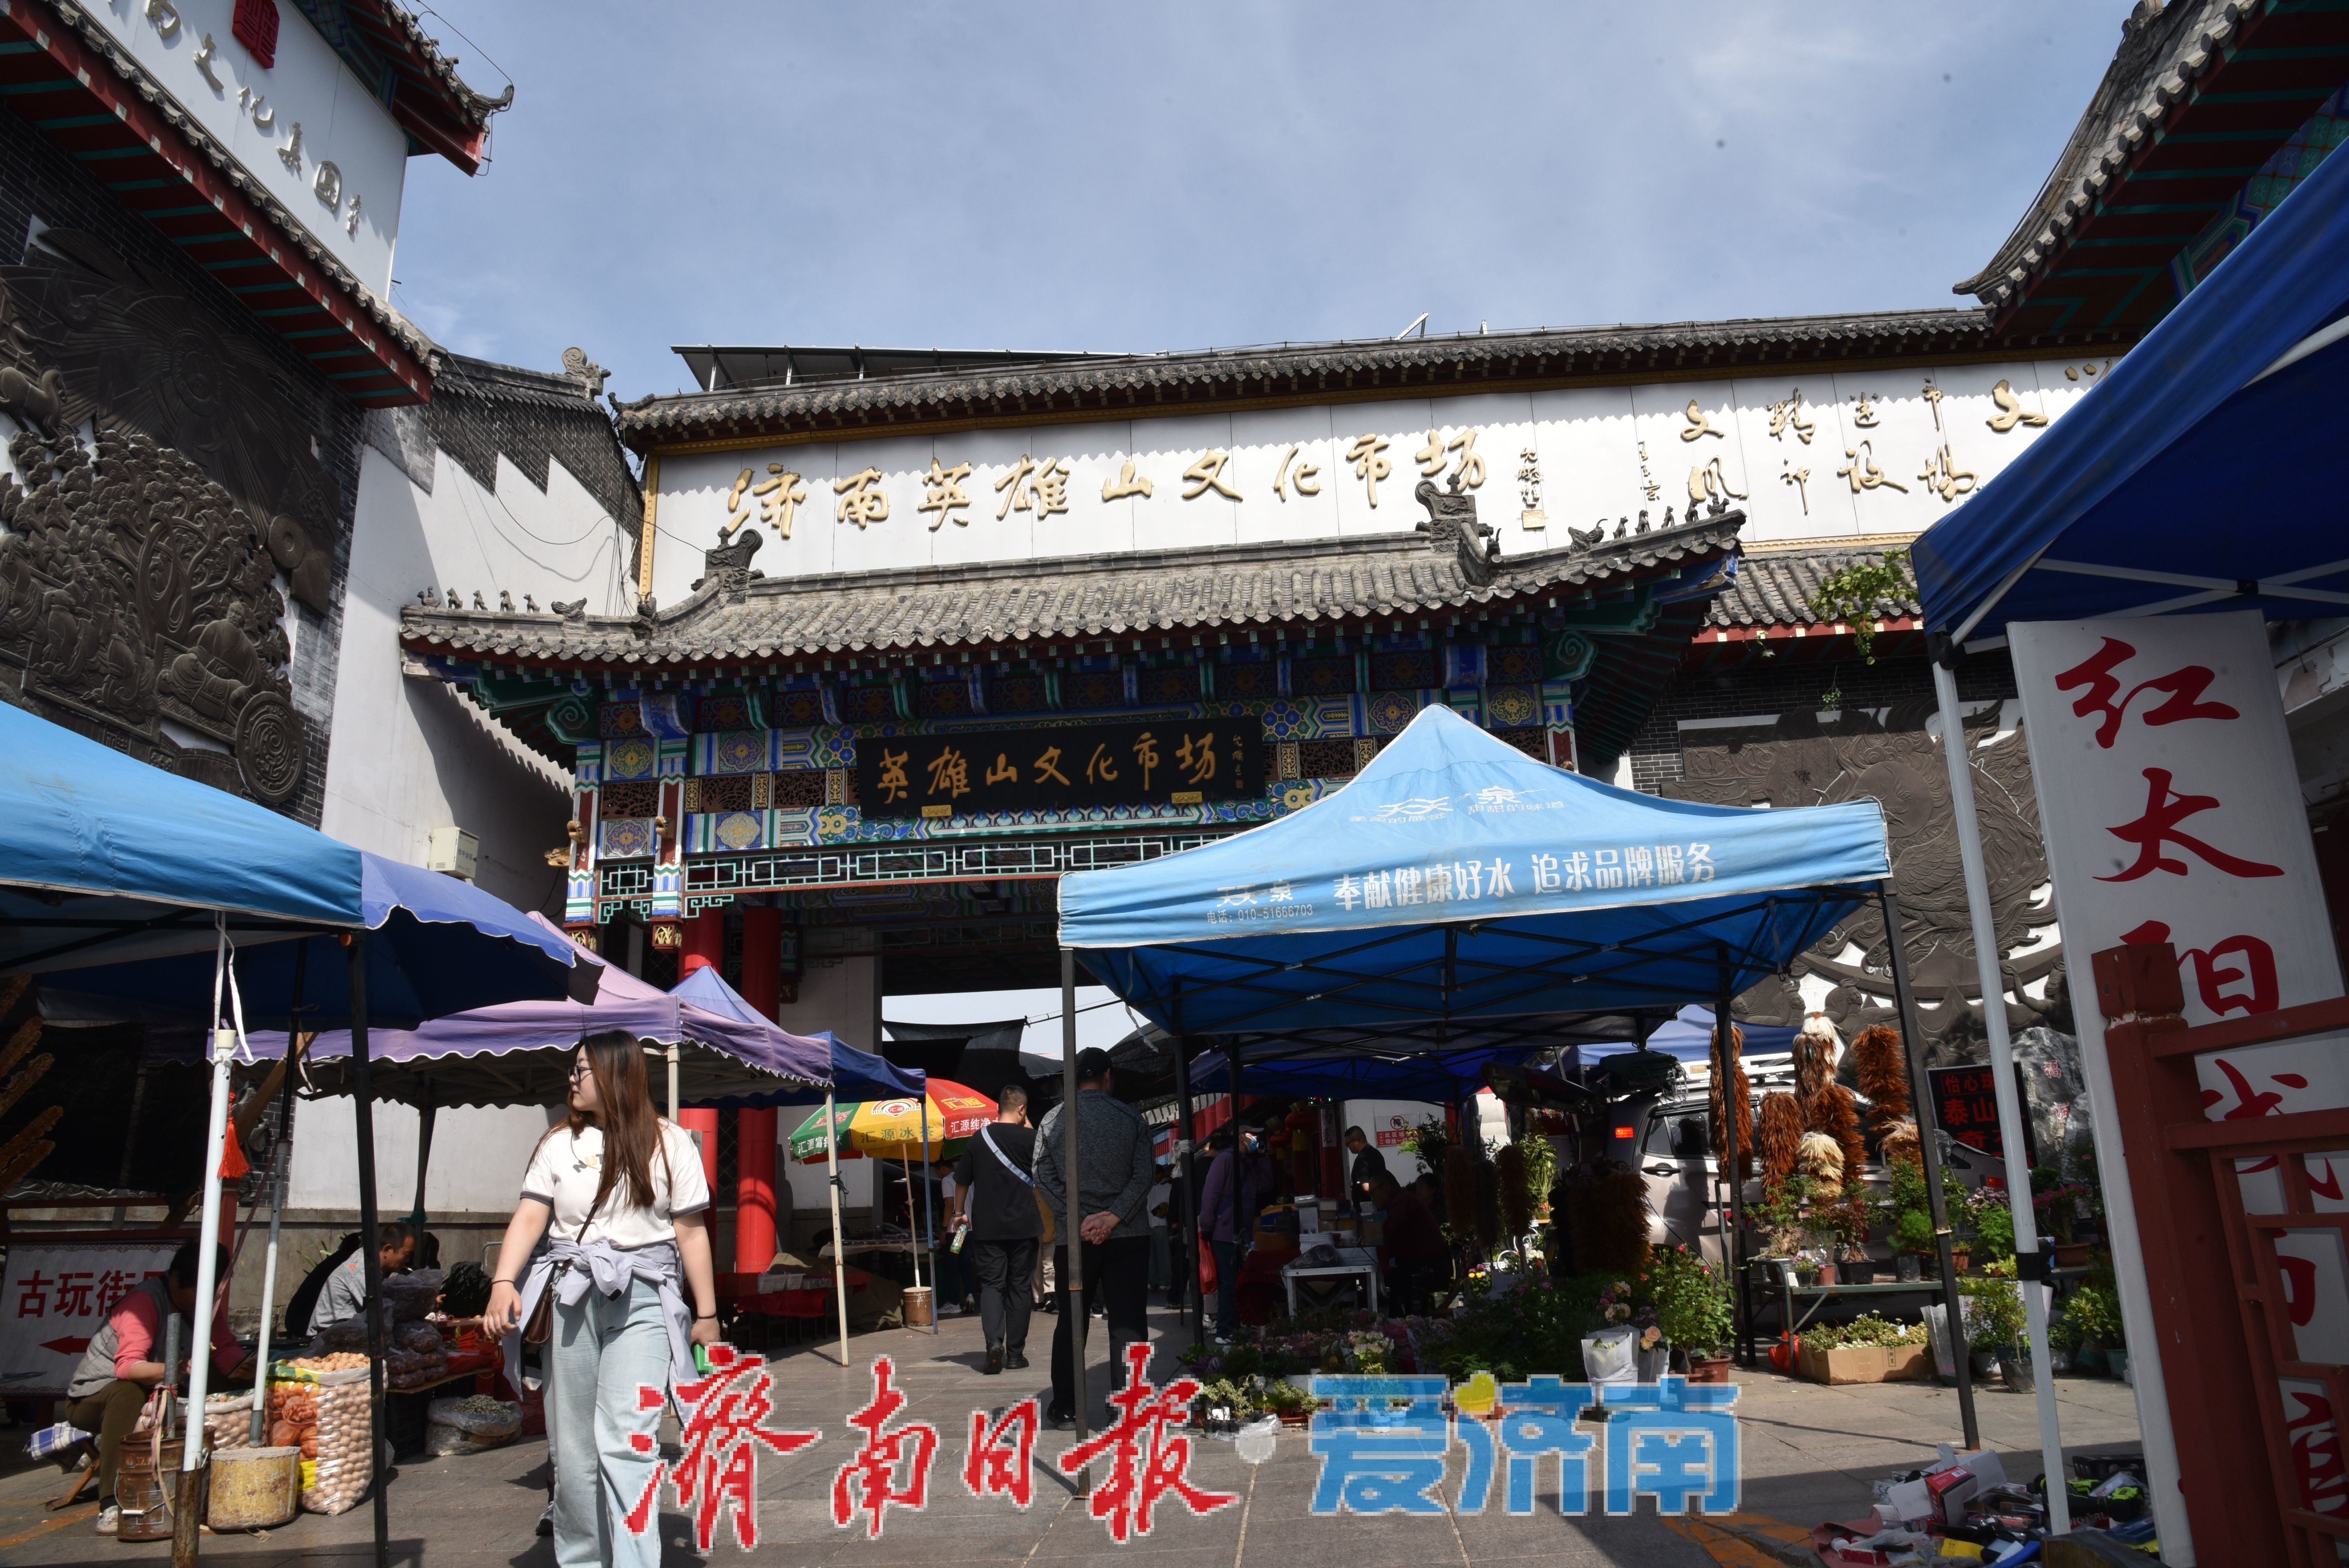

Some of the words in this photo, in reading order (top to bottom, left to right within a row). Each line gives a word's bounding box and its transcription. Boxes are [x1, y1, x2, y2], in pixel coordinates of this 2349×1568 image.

[726, 426, 1486, 540] 济南英雄山文化市场
[877, 732, 1215, 804] 英雄山文化市场
[1349, 812, 1446, 824] 柔柔的感觉
[1467, 801, 1565, 815] 甜甜的味道
[1333, 857, 1515, 911] 奉献健康好水
[1531, 842, 1716, 895] 追求品牌服务
[17, 1270, 166, 1319] 古玩街
